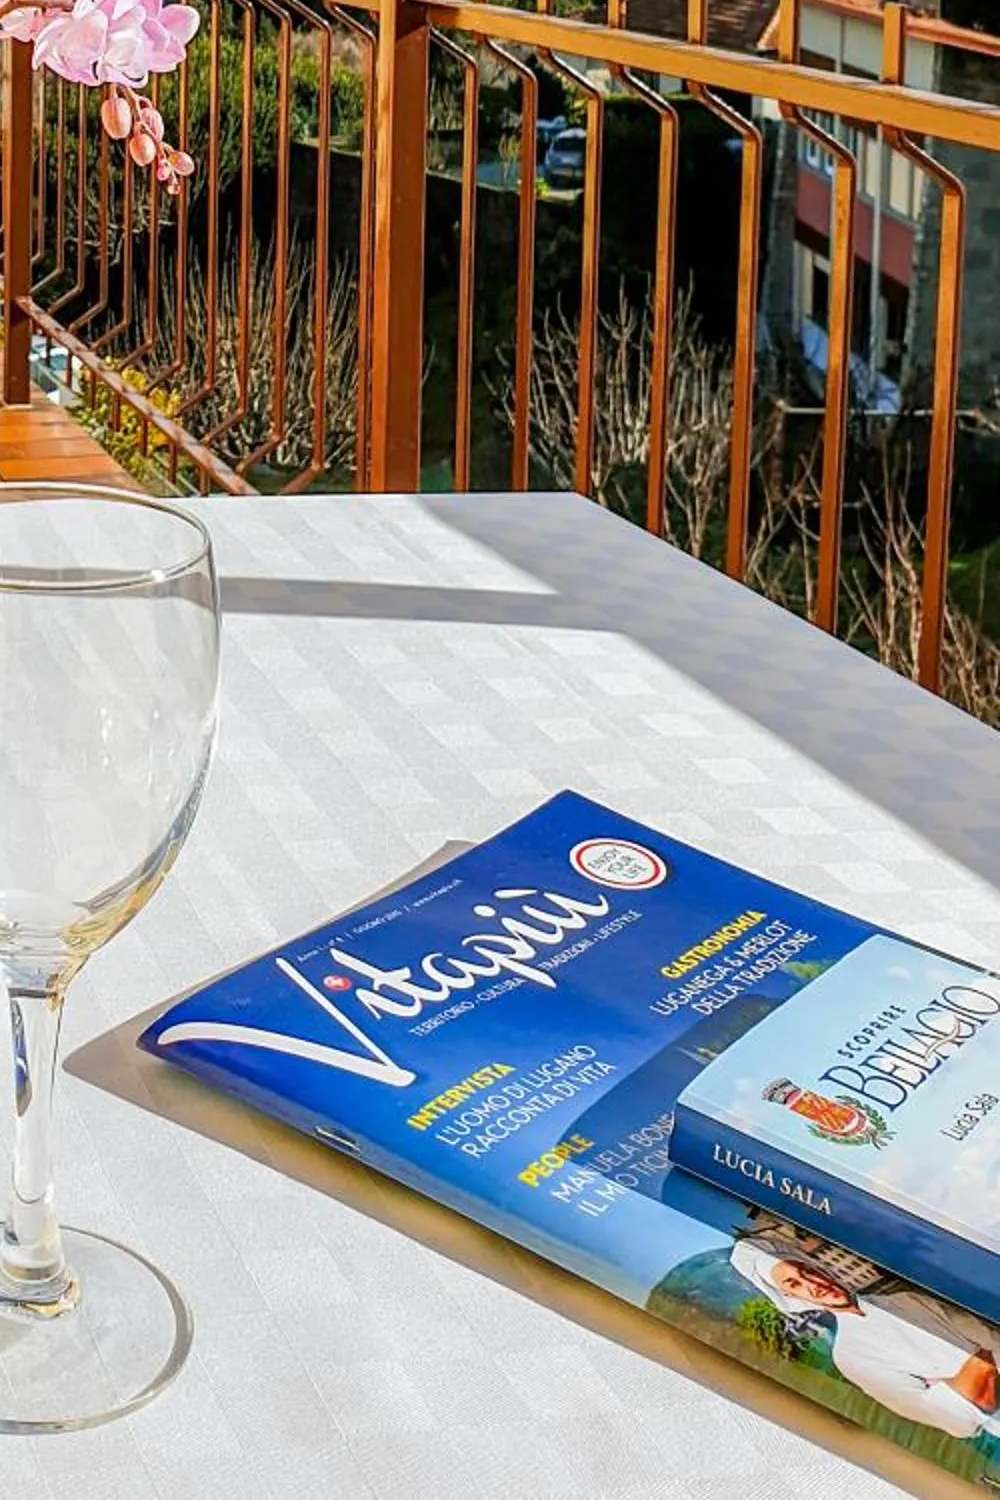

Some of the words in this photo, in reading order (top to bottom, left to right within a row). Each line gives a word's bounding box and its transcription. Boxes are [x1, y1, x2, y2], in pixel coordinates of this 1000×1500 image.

[408, 999, 475, 1037] TERRITORIO
[476, 976, 528, 1003] CULTURA
[596, 909, 643, 941] LIFESTYLE
[649, 964, 735, 1016] LUGANEGA
[734, 920, 793, 960] MERLOT
[660, 910, 767, 979] GASTRONOMIA
[691, 983, 745, 1016] DELLA
[732, 930, 818, 985] TRADIZIONE
[157, 888, 610, 1087] Vitapiù
[836, 1004, 907, 1060] SCOPRIRE
[407, 1063, 516, 1131] INTERVISTA
[435, 1094, 510, 1146] L'UOMO
[503, 1081, 532, 1100] DI
[528, 1044, 597, 1089] LUGANO
[461, 1092, 560, 1159] RACCONTA
[552, 1079, 582, 1098] DI
[574, 1060, 618, 1087] VITA
[940, 1113, 980, 1141] Lucia
[965, 1093, 1000, 1116] Sala
[517, 1133, 596, 1188] PEOPLE
[551, 1141, 637, 1204] MANUELA
[577, 1199, 609, 1218] IL
[595, 1173, 640, 1202] MIO
[714, 1143, 775, 1190] LUCIA
[779, 1175, 833, 1217] SALA
